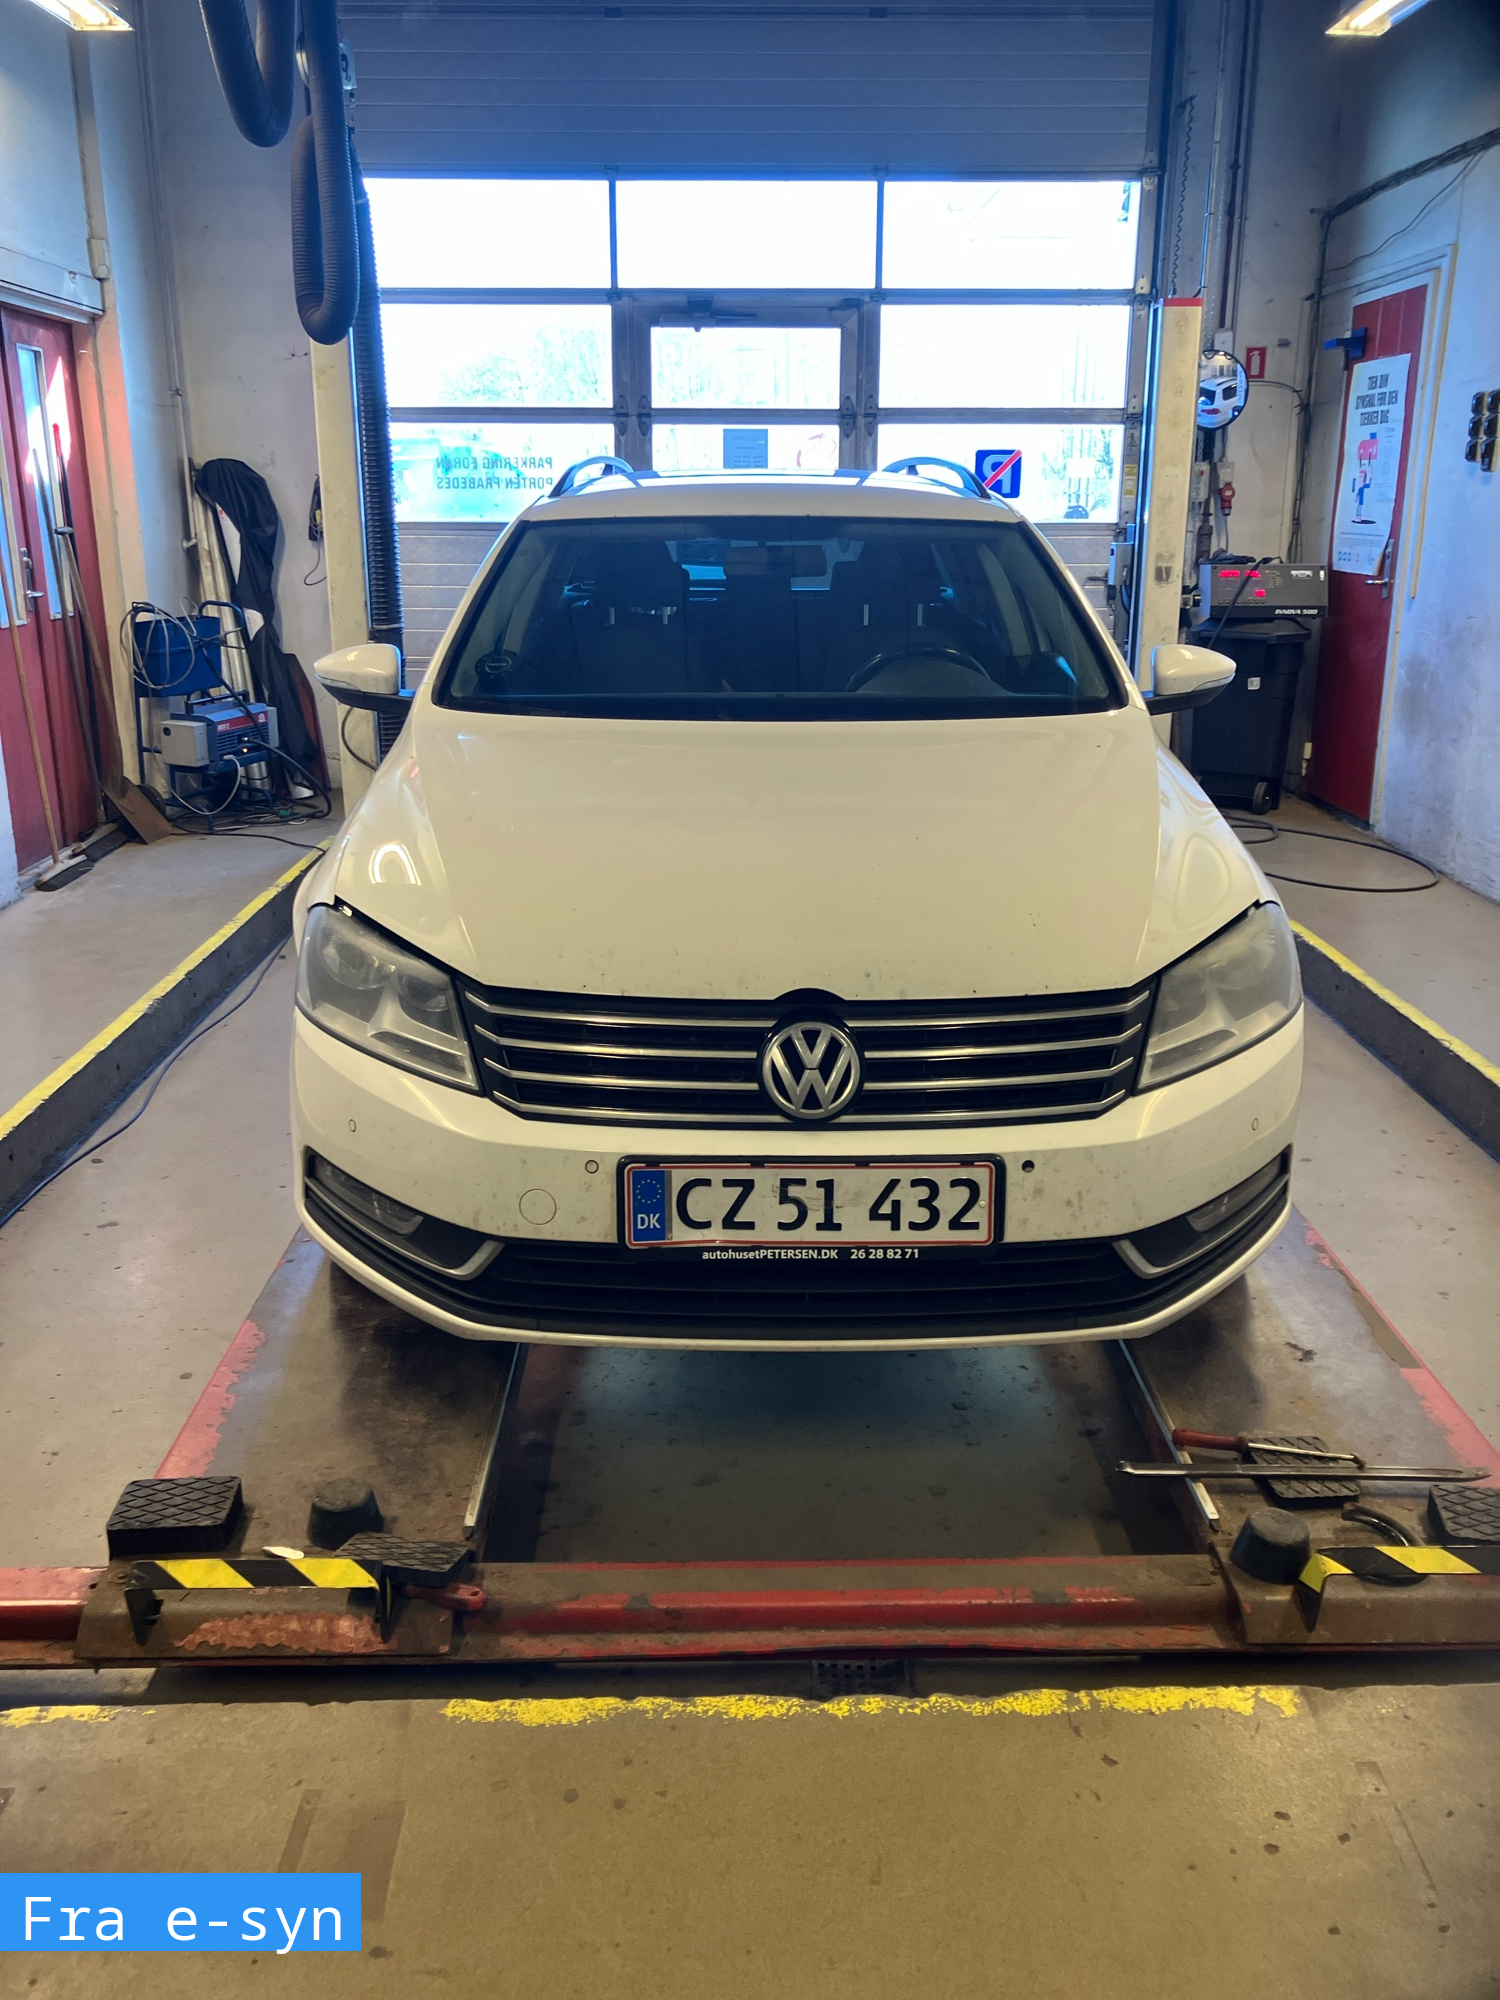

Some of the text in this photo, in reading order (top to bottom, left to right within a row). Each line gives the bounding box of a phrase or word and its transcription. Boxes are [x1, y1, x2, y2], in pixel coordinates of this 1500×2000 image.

[763, 1022, 860, 1119] VW
[637, 1213, 661, 1229] DK
[676, 1177, 981, 1231] CZ 51 432
[702, 1248, 919, 1260] autohusetPETERSEN.DK 26 28 82 71
